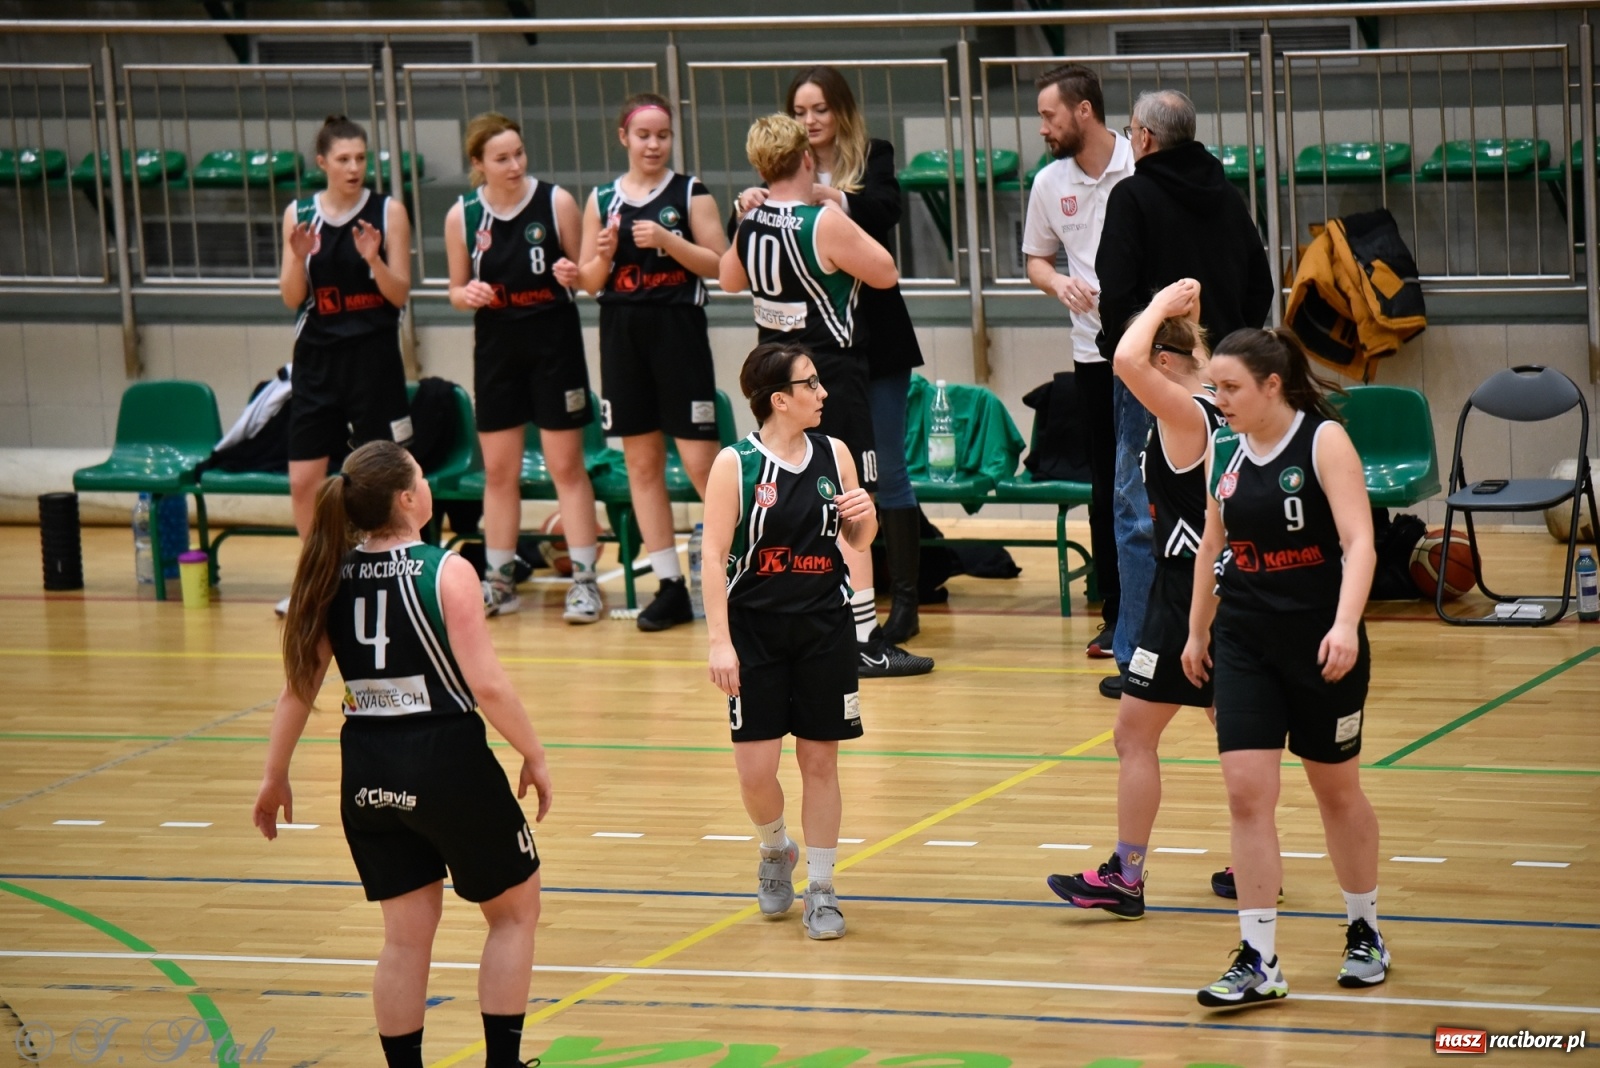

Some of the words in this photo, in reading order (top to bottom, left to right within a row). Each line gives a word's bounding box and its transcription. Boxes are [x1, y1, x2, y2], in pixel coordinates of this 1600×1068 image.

[530, 246, 546, 275] 8
[747, 231, 782, 296] 10
[861, 449, 878, 483] 10
[820, 503, 839, 537] 13
[1283, 496, 1305, 532] 9
[353, 589, 391, 671] 4
[367, 787, 417, 807] Clavis
[516, 821, 536, 861] 4
